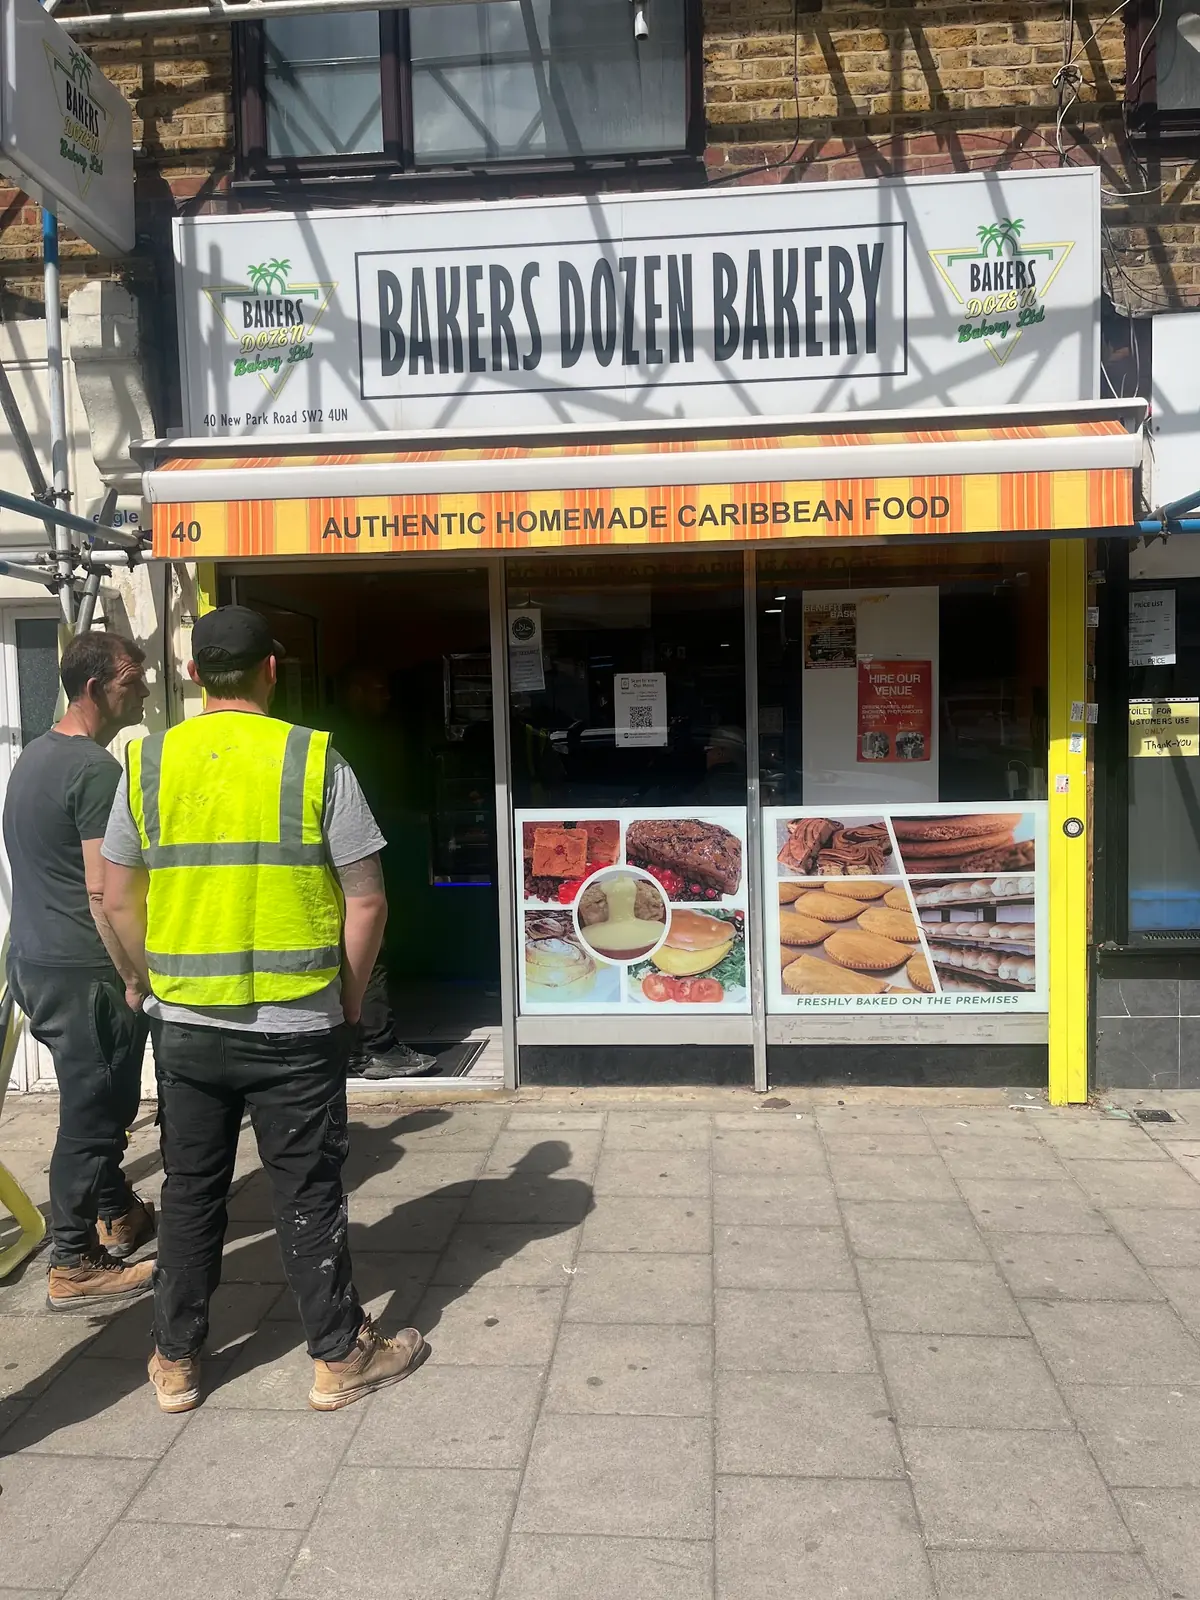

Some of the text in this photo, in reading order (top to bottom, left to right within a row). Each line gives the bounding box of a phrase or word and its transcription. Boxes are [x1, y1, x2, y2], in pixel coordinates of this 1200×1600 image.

[66, 80, 99, 137] BAKERS
[64, 115, 101, 155] DOZEN
[59, 137, 103, 175] Bakery Ltd
[971, 259, 1036, 292] BAKERS
[243, 299, 304, 328] BAKERS
[378, 243, 884, 376] BAKERS DOZEN BAKERY
[965, 286, 1037, 319] DOZEN
[957, 305, 1045, 343] Bakery Ltd
[240, 324, 305, 354] DOZEN
[234, 342, 314, 377] Bakery Ltd
[203, 408, 348, 427] 40 New Park Road SW2 4UN
[93, 509, 139, 527] egle
[322, 495, 950, 539] AUTHENTIC HOMEMADE CARIBBEAN FOOD
[171, 521, 202, 543] 40
[1134, 600, 1151, 608] PRICE
[869, 674, 921, 683] HIRE OUR
[875, 685, 913, 696] VENUE
[1130, 718, 1172, 726] USTOMERS
[1156, 707, 1172, 715] FOR
[1144, 727, 1166, 735] ONLY
[796, 995, 1019, 1007] FRESHLY BAKED ON THE PREMISES
